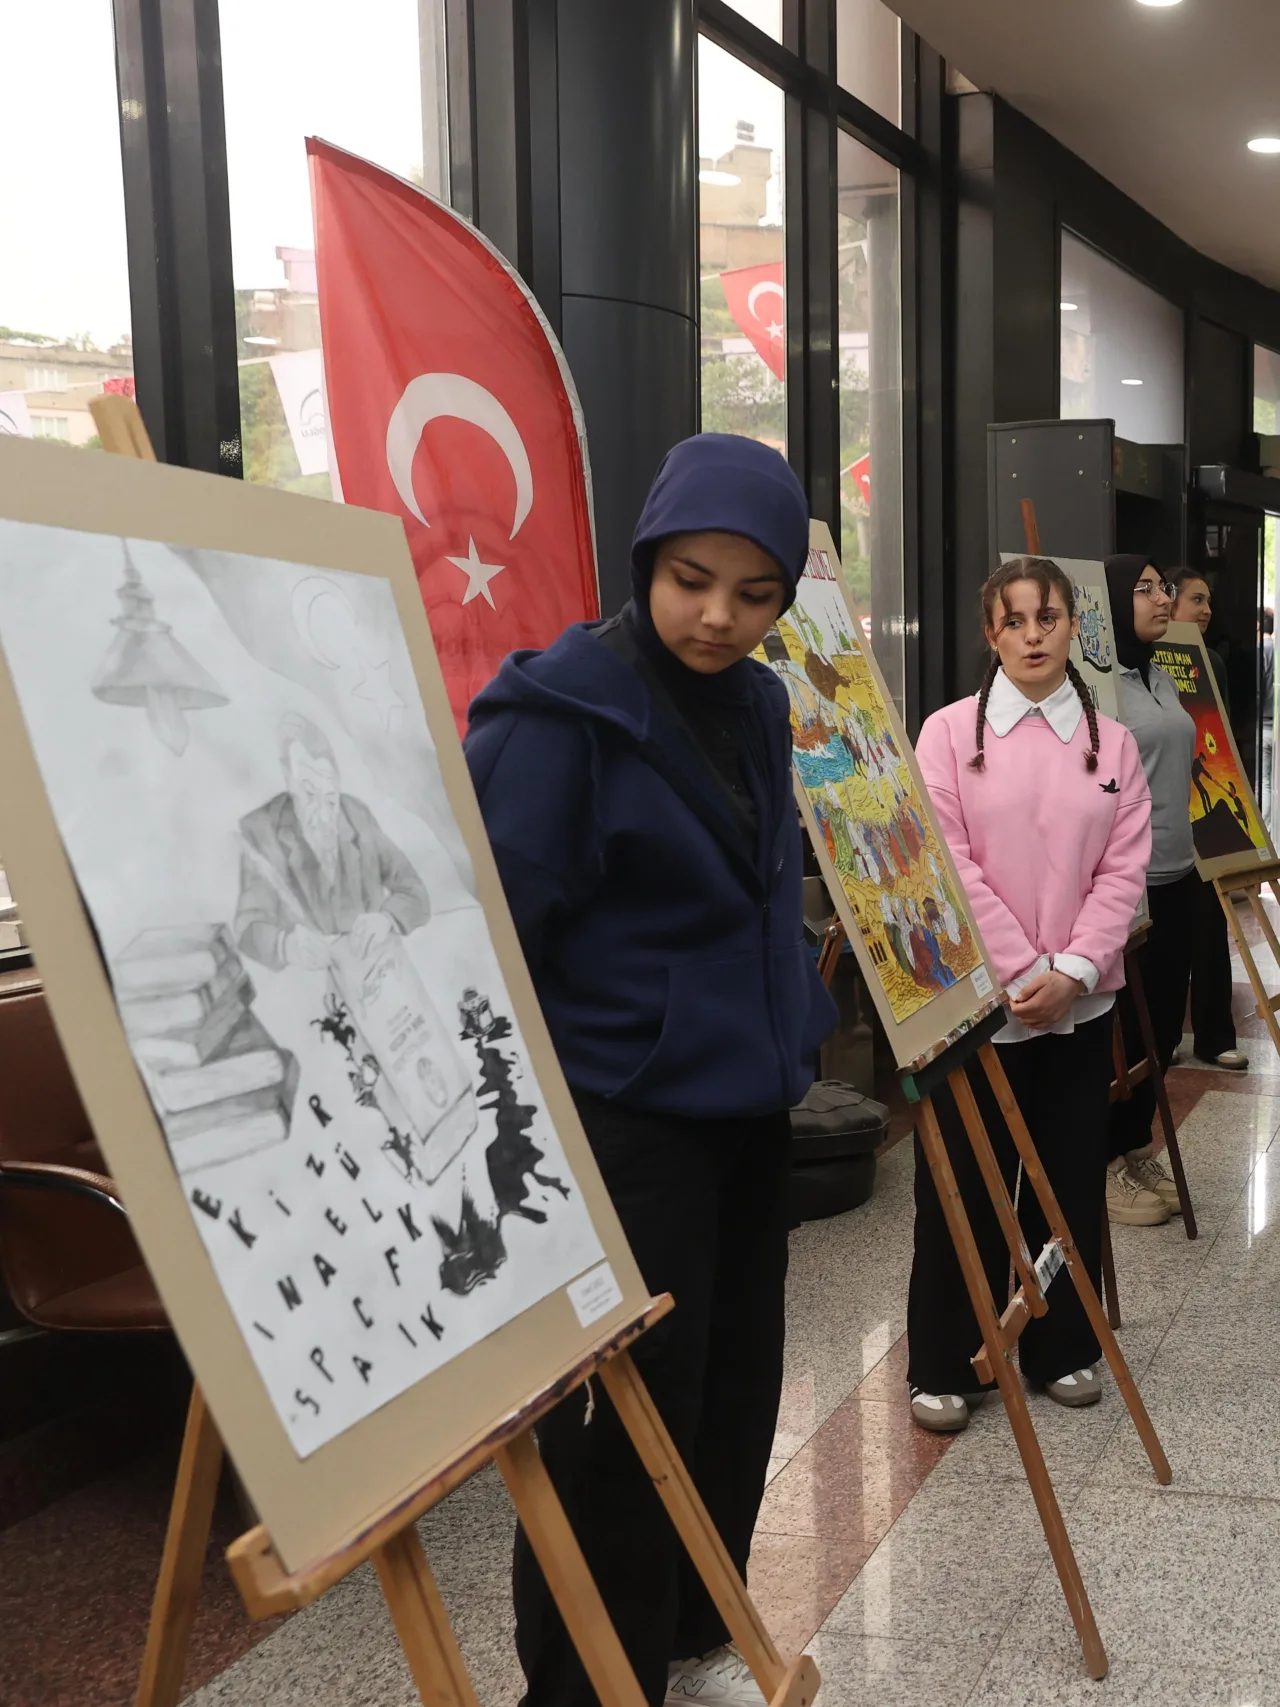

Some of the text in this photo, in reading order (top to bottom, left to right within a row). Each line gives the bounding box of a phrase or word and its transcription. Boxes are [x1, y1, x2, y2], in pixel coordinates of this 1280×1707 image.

[308, 1093, 333, 1128] R
[305, 1153, 326, 1178] Z
[191, 1188, 222, 1220] E
[362, 1198, 383, 1223] L
[228, 1208, 257, 1249] K
[324, 1208, 348, 1236] E
[397, 1203, 422, 1241] K
[312, 1254, 337, 1287] A
[384, 1246, 401, 1286] F
[277, 1275, 302, 1311] N
[352, 1297, 374, 1329] C
[420, 1304, 444, 1341] K
[310, 1346, 334, 1383] P
[352, 1355, 373, 1383] A
